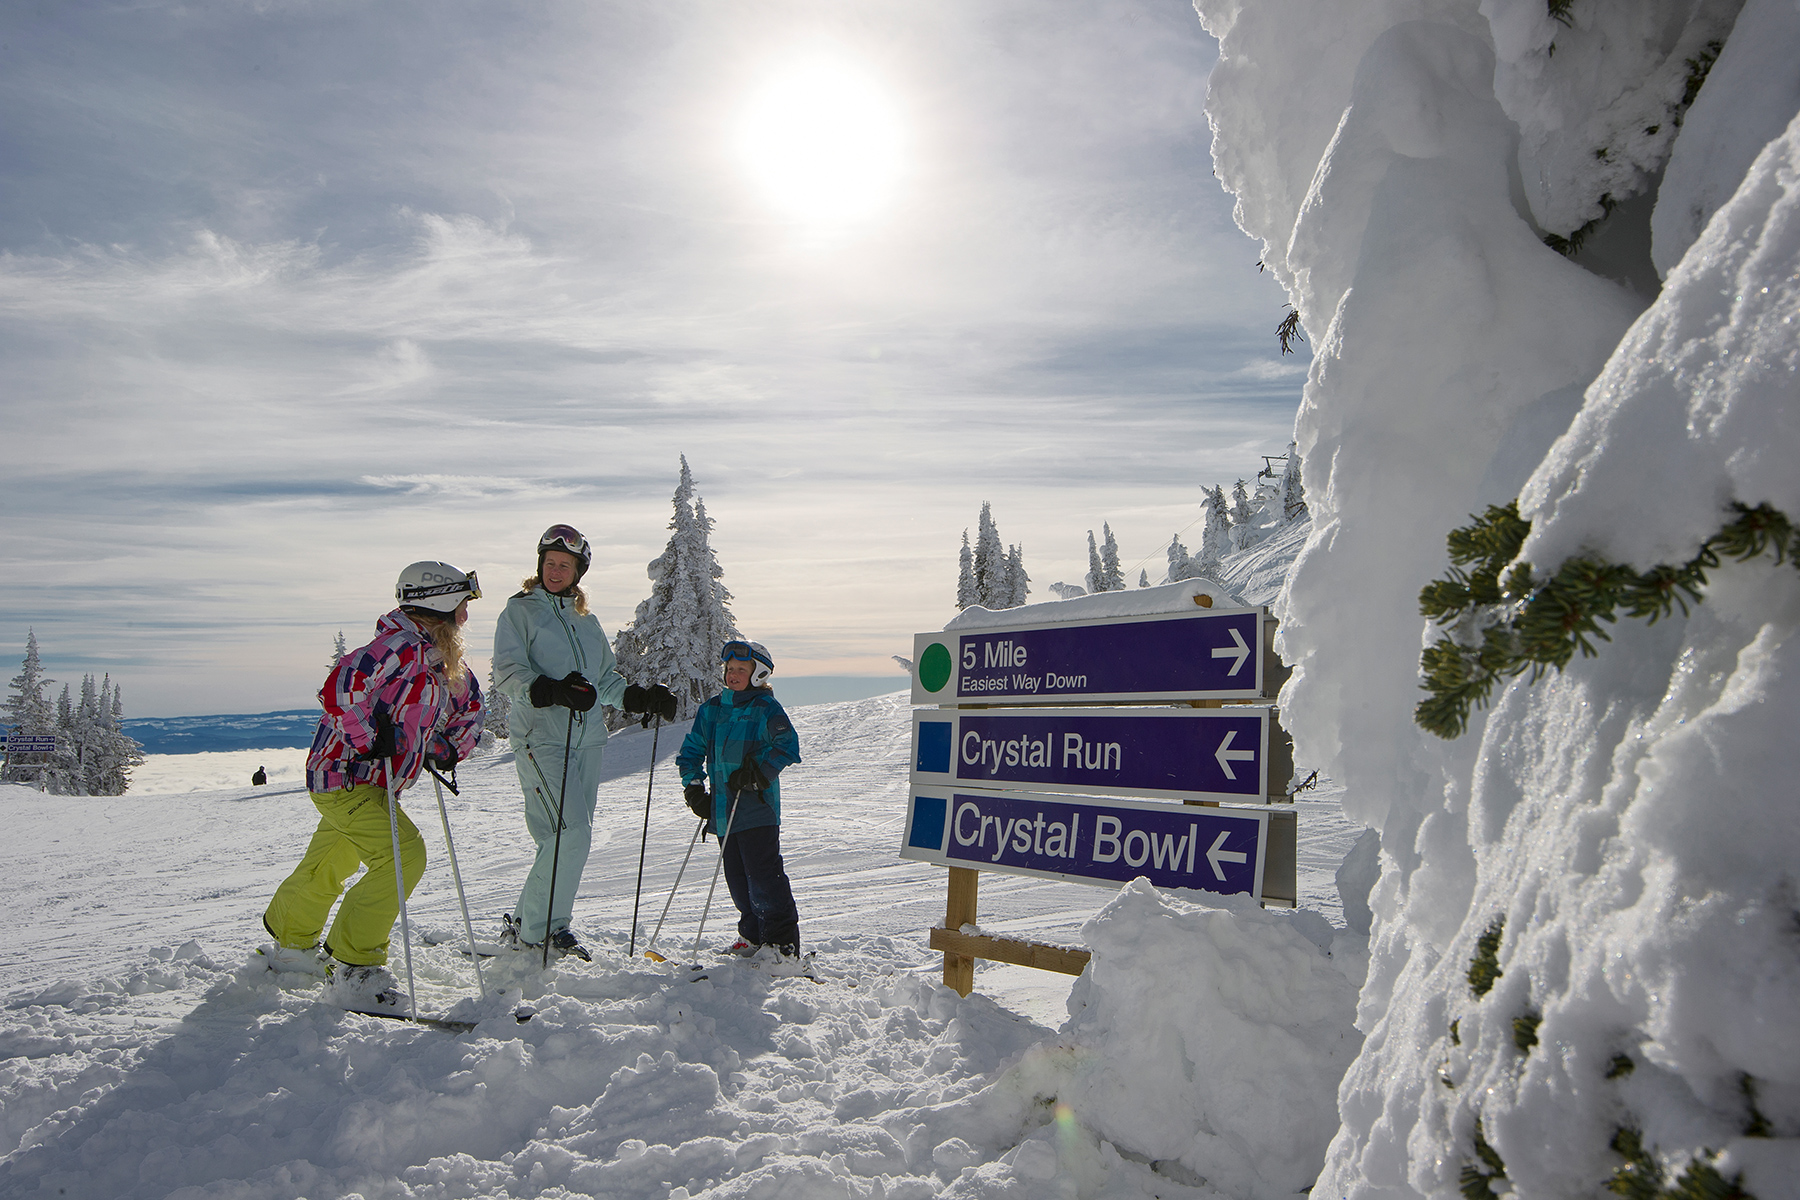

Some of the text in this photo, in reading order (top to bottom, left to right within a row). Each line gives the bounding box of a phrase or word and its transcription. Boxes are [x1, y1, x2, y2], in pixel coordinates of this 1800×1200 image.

[962, 640, 1027, 670] 5 Mile
[961, 672, 1088, 694] Easiest Way Down
[961, 730, 1121, 775] Crystal Run
[954, 801, 1198, 874] Crystal Bowl
